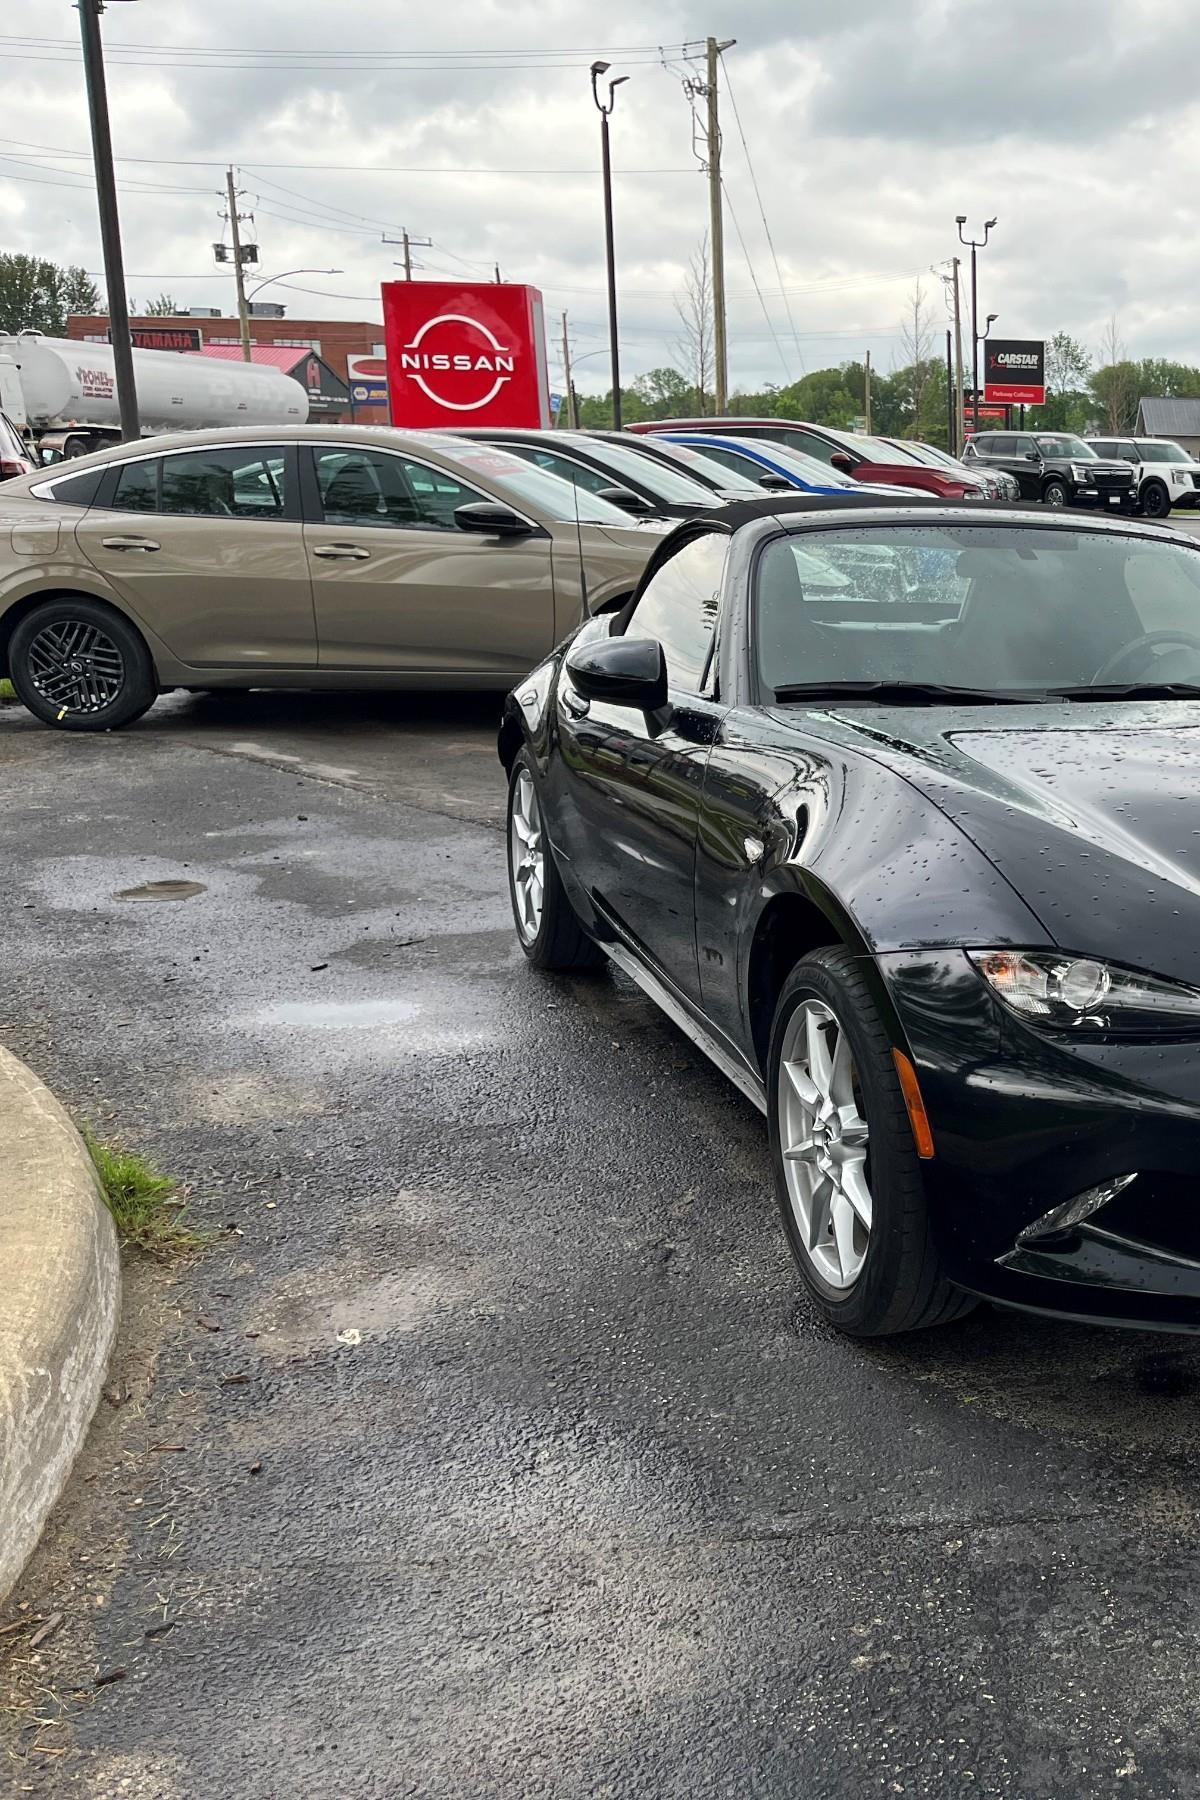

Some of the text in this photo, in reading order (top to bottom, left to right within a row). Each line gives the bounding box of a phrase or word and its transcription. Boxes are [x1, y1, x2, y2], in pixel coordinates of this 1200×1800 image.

[134, 333, 193, 348] YAMAHA
[401, 353, 514, 372] NISSAN
[997, 353, 1038, 365] CARSTAR
